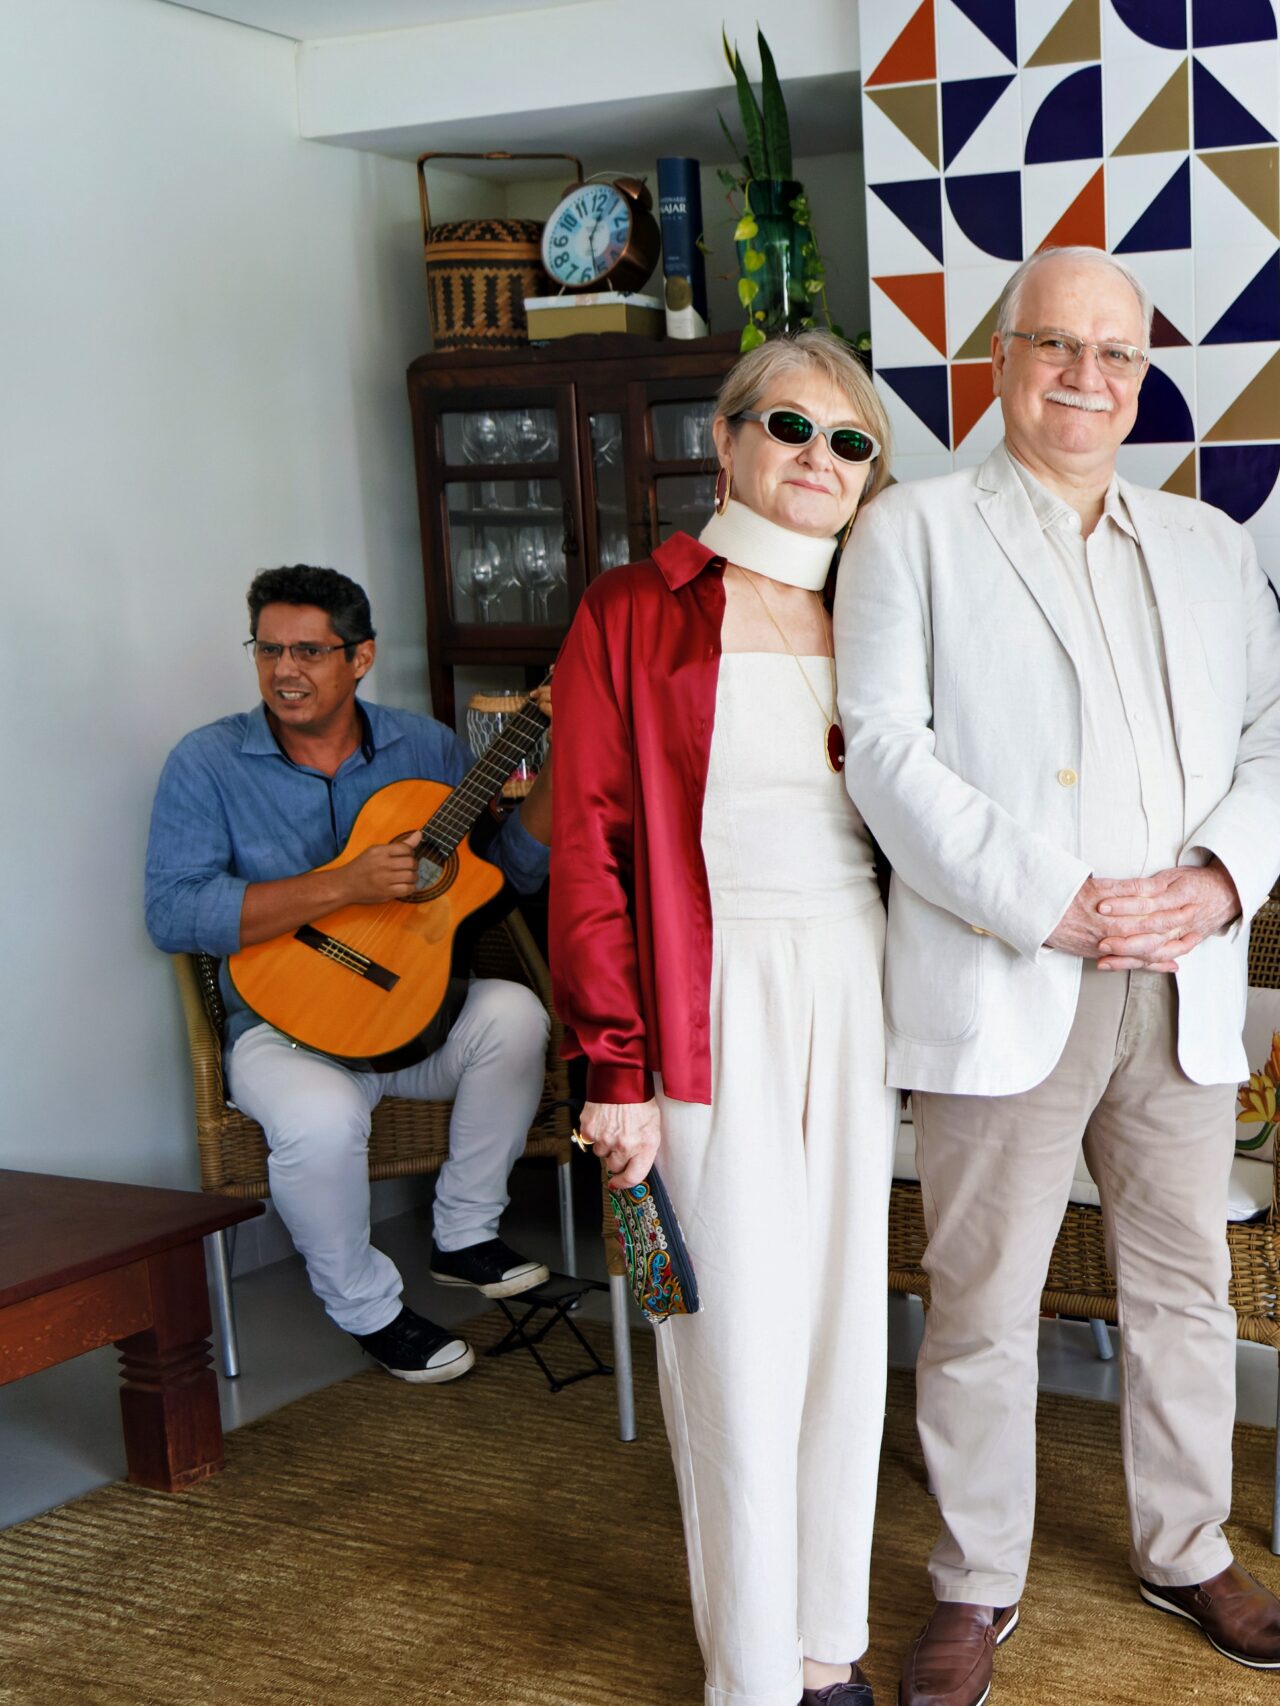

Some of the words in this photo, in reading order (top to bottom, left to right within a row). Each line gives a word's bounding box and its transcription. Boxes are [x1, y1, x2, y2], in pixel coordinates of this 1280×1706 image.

[576, 200, 588, 218] 11
[592, 193, 608, 212] 12
[560, 213, 578, 232] 10
[553, 251, 570, 269] 8
[565, 263, 580, 281] 7
